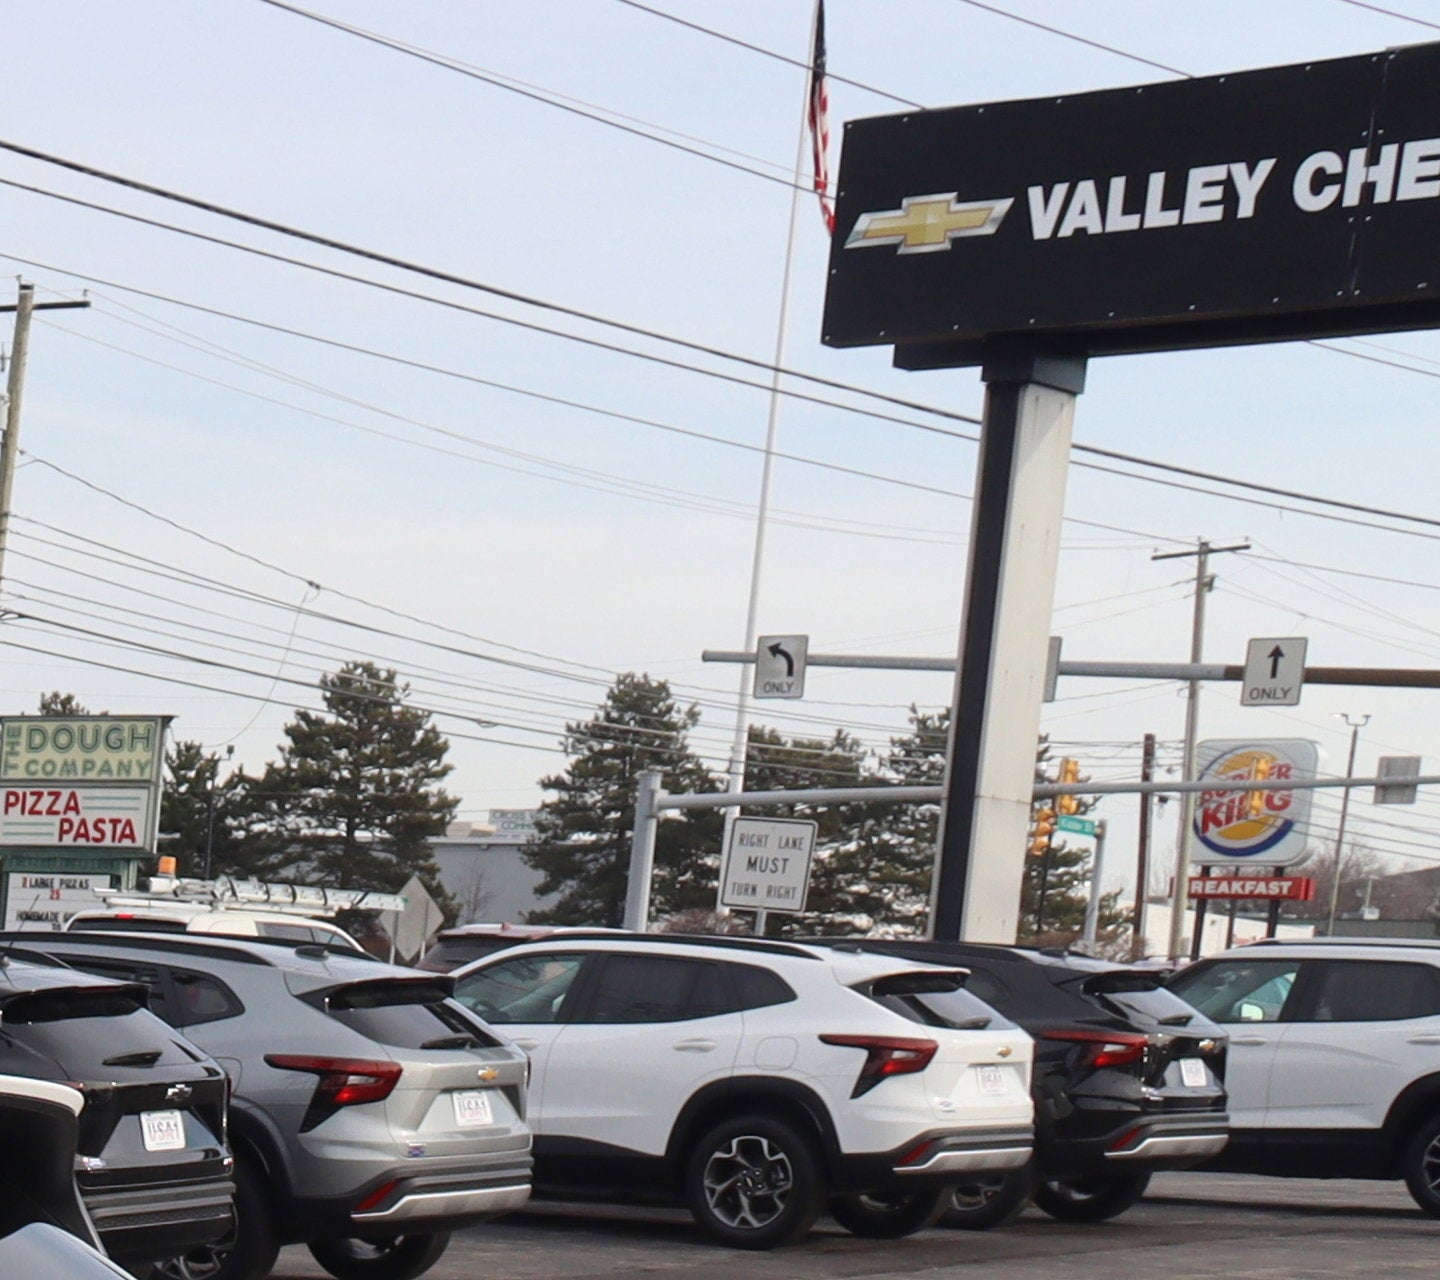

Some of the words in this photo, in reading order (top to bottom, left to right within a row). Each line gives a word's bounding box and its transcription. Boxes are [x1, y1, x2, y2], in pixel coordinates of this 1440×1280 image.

[1027, 157, 1276, 240] VALLEY
[1292, 138, 1440, 213] CHE
[763, 681, 794, 693] ONLY
[1249, 687, 1292, 700] ONLY
[26, 723, 154, 753] DOUGH
[4, 724, 22, 776] THE
[24, 758, 151, 777] COMPANY
[1200, 763, 1292, 805] BUER
[4, 790, 80, 816] PIZZA
[58, 817, 137, 844] PASTA
[739, 833, 769, 849] RIGHT
[778, 836, 804, 851] LANE
[746, 856, 789, 874] MUST
[29, 877, 54, 888] LARGE
[731, 882, 758, 896] TURN
[766, 885, 797, 900] RIGHT
[1190, 880, 1293, 896] REAKFAST
